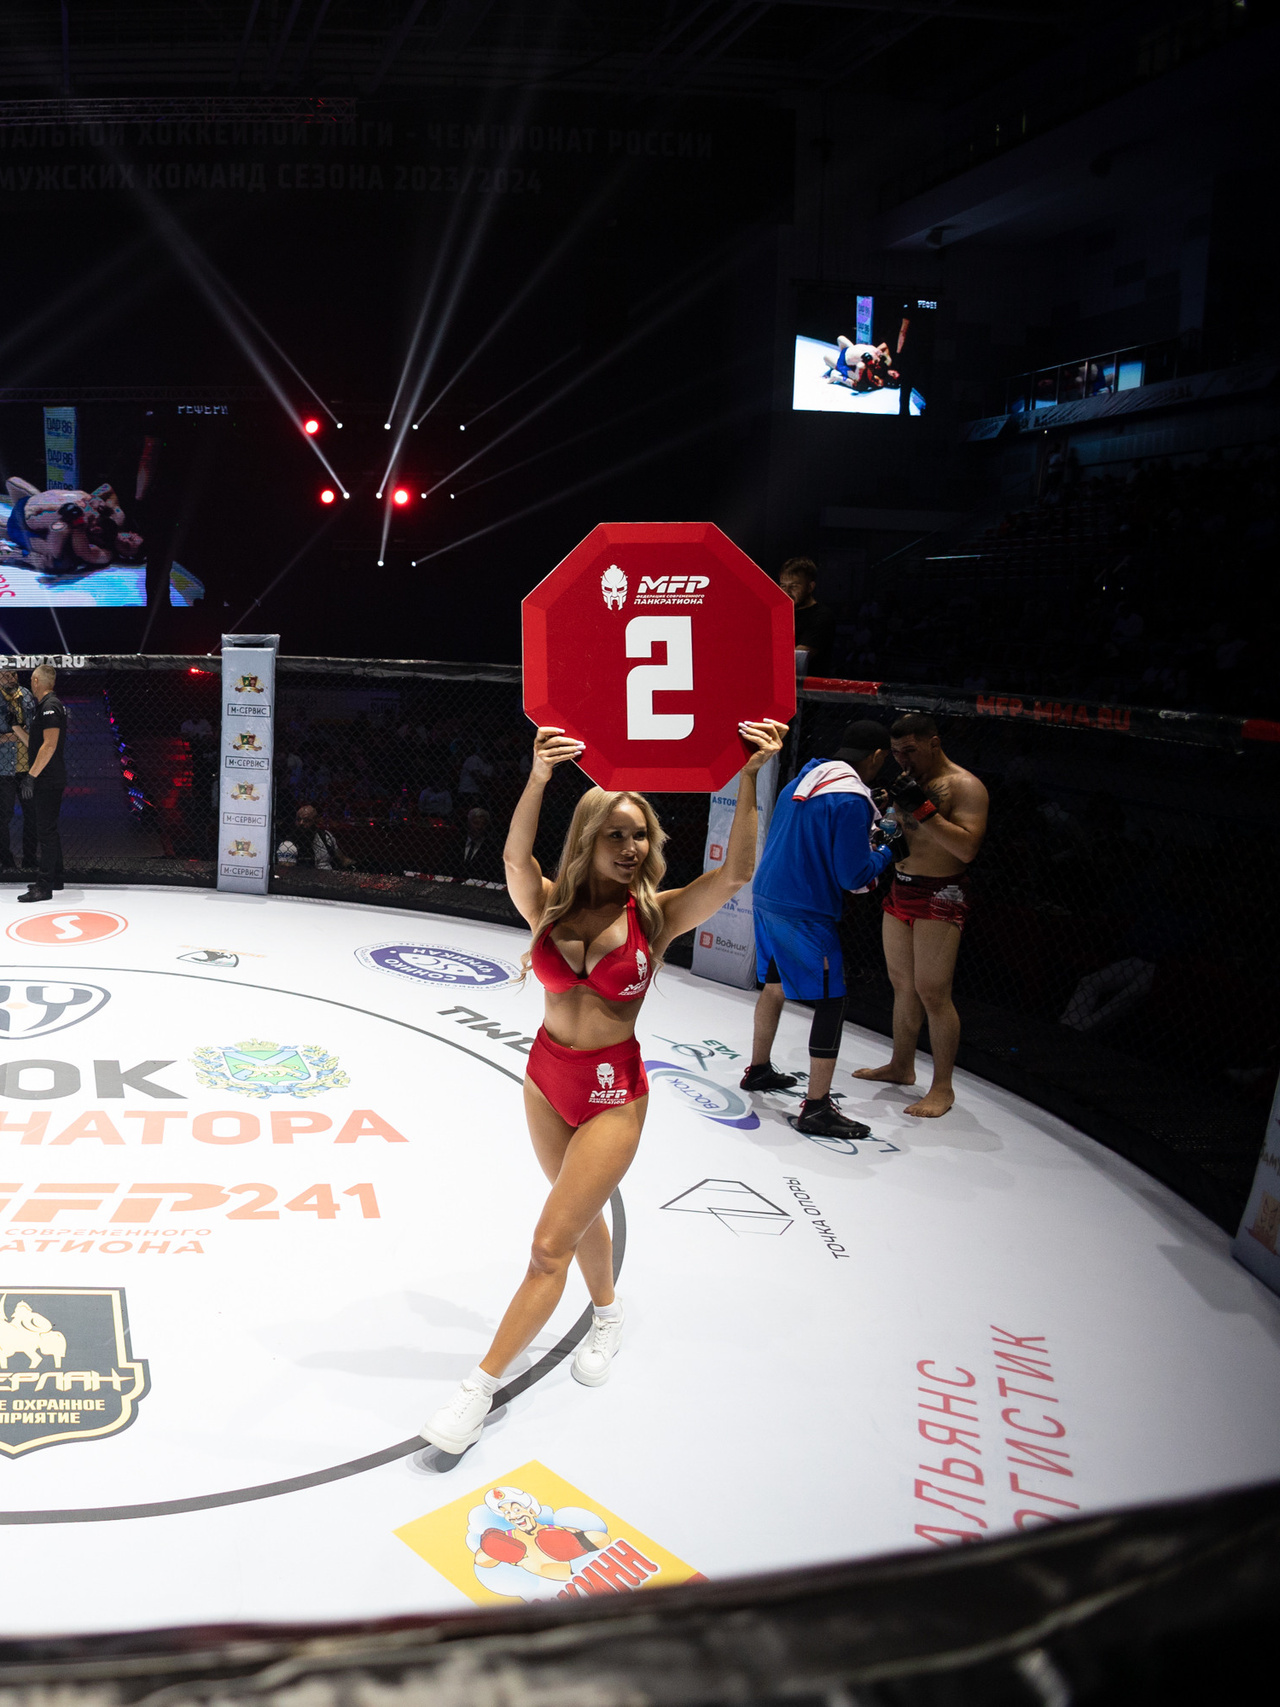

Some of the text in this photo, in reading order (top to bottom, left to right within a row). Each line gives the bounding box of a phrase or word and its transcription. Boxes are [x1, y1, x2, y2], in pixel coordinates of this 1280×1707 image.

[427, 122, 595, 153] ЧЕМПИОНАТ
[607, 129, 714, 158] РОССИИ
[146, 162, 267, 192] КОМАНД
[277, 162, 384, 190] СЕЗОНА
[637, 576, 710, 593] MFP
[625, 616, 694, 740] 2
[976, 694, 1131, 731] MFP-MMA.RU
[715, 936, 747, 951] Водник
[590, 1089, 628, 1099] MFP
[666, 1077, 721, 1111] ВОСТОК
[4, 1228, 212, 1237] СОВРЕМЕННОГО
[782, 1176, 850, 1260] ТОЧКА ОПОРЫ
[12, 1399, 105, 1411] ОХРАННОЕ
